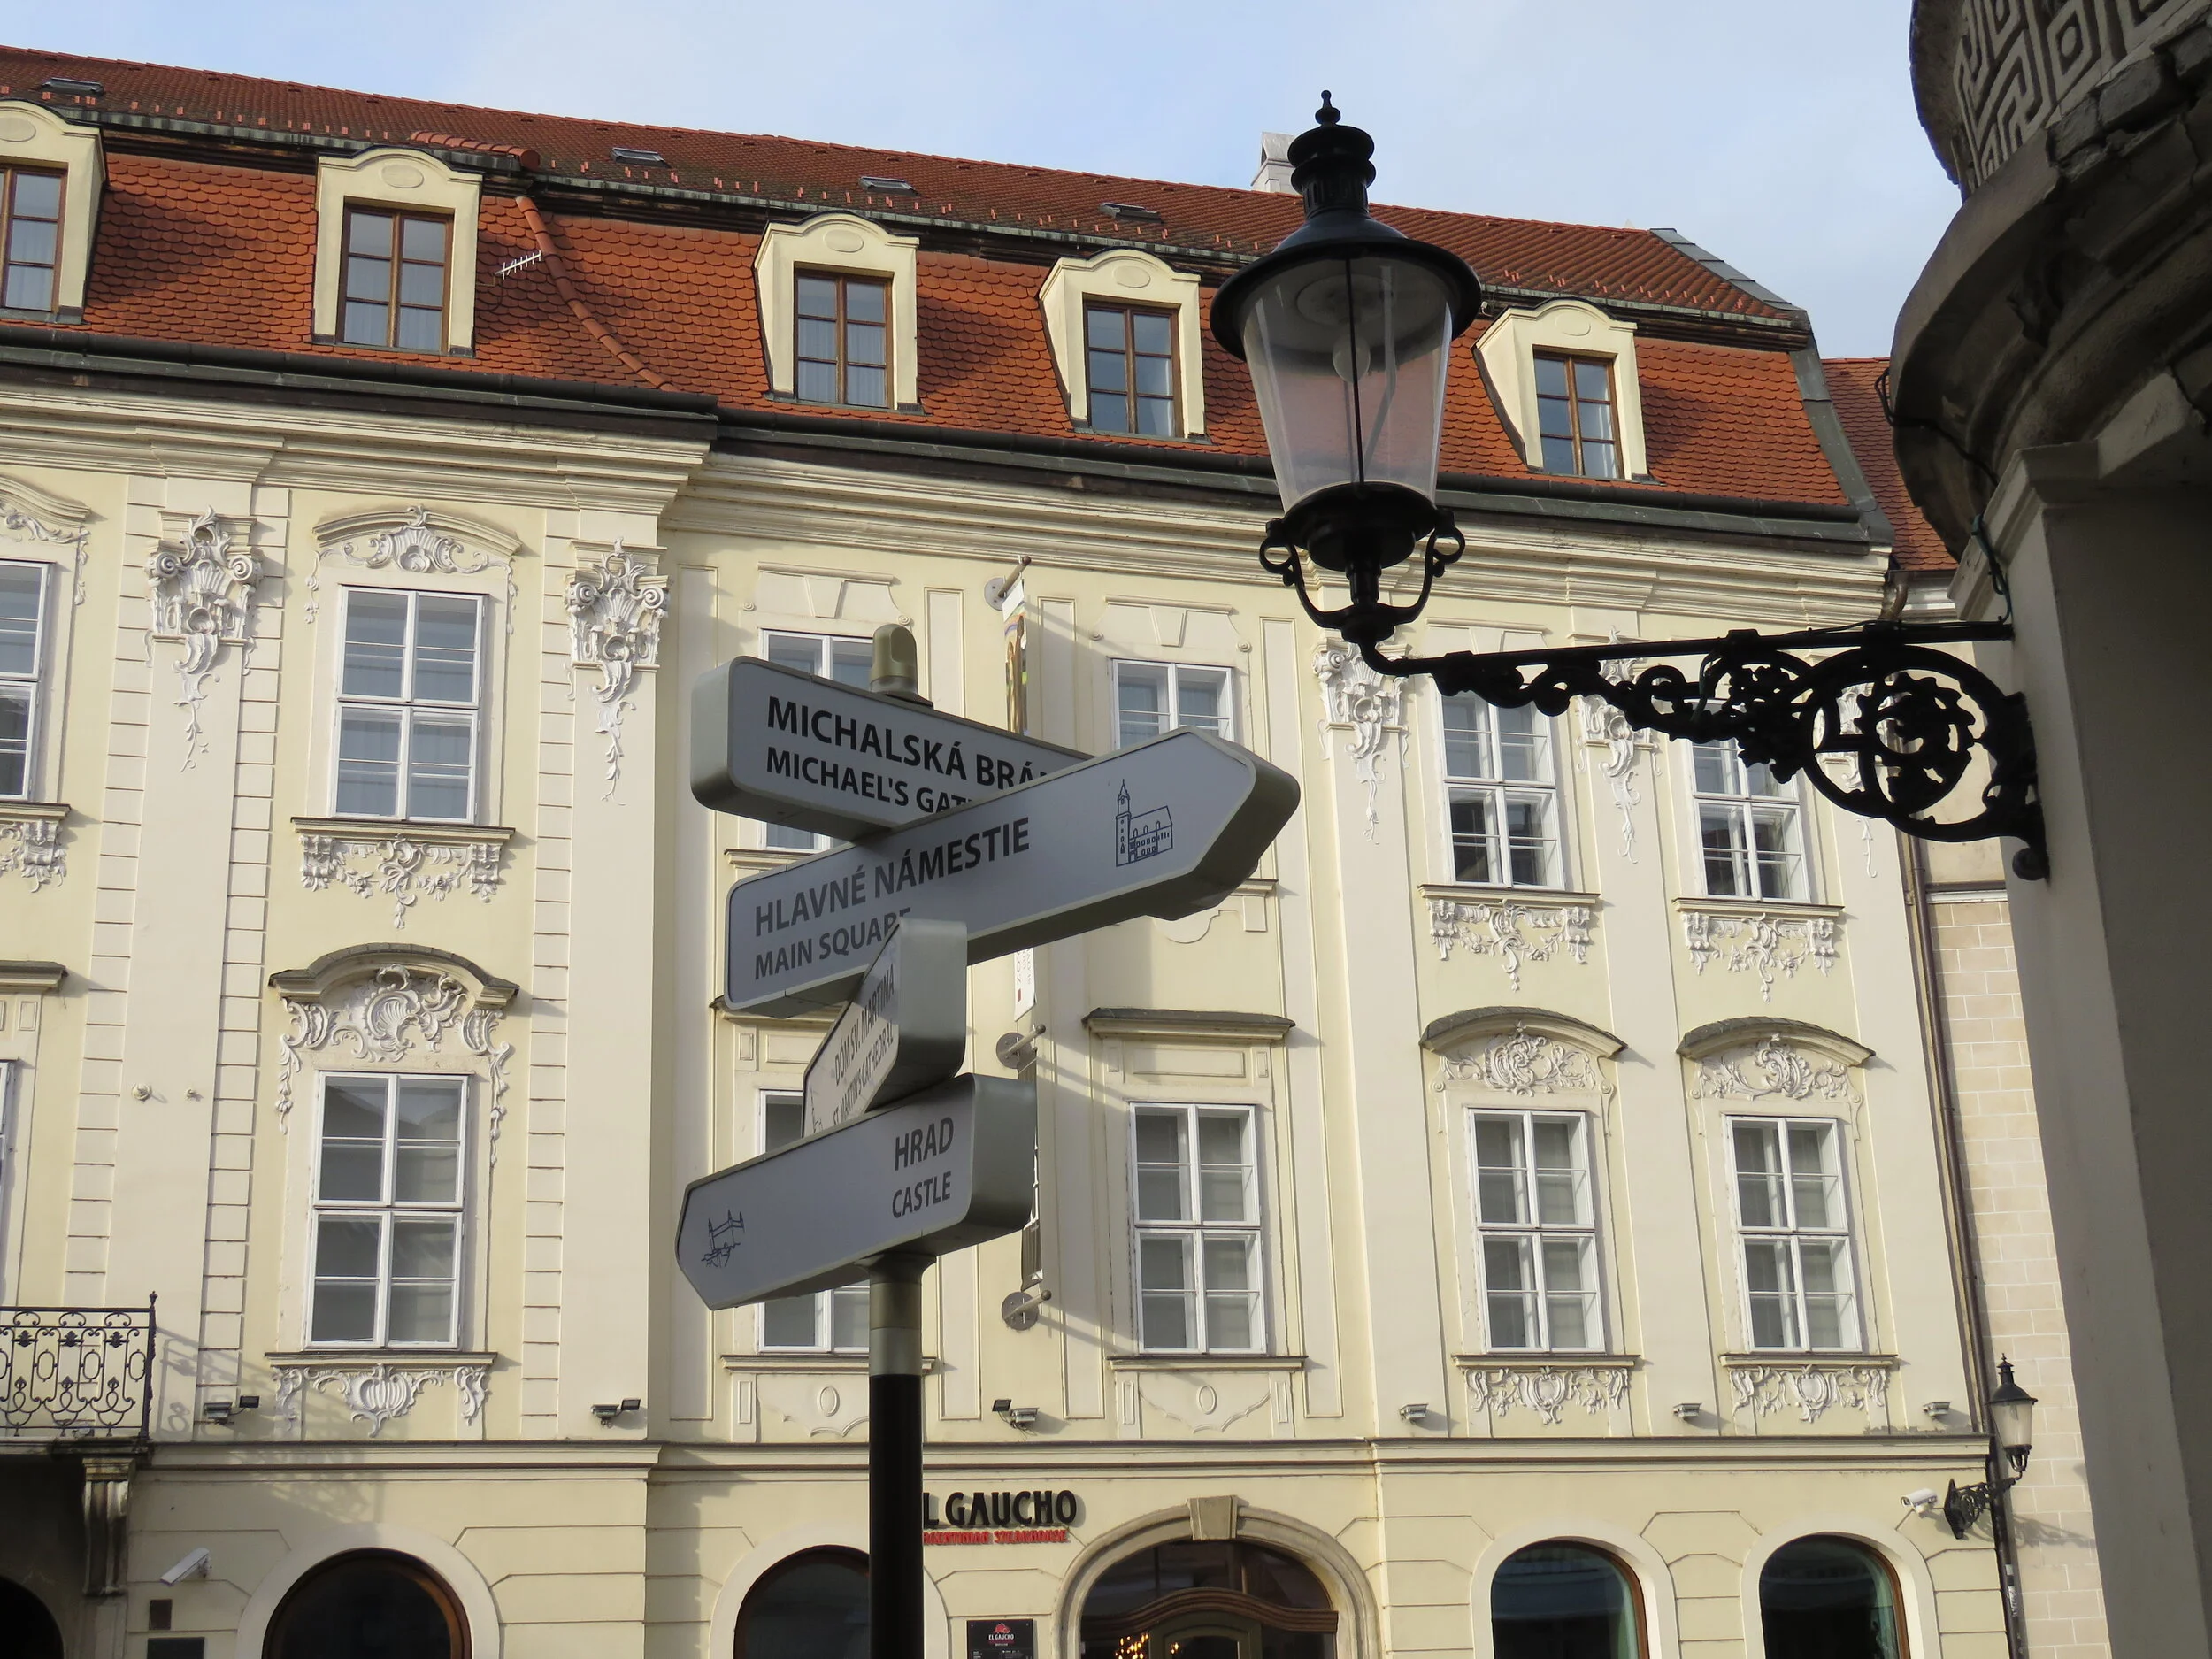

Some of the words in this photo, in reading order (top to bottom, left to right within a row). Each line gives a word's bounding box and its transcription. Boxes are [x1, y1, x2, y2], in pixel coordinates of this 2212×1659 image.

[768, 696, 967, 780] MICHALSKÁ
[976, 754, 1047, 790] BRÁ
[766, 747, 909, 806] MICHAEL'S
[917, 787, 972, 813] GAT
[756, 865, 866, 937] HLAVNÉ
[875, 817, 1030, 898] NÁMESTIE
[755, 939, 812, 980] MAIN
[861, 964, 895, 1044] MARTINA
[862, 1019, 894, 1088] CATHEDRAL
[895, 1117, 954, 1171] HRAD
[892, 1171, 951, 1218] CASTLE
[923, 1492, 940, 1529] L
[945, 1490, 1077, 1527] GAUCHO
[994, 1530, 1067, 1543] STEAKHOUSE
